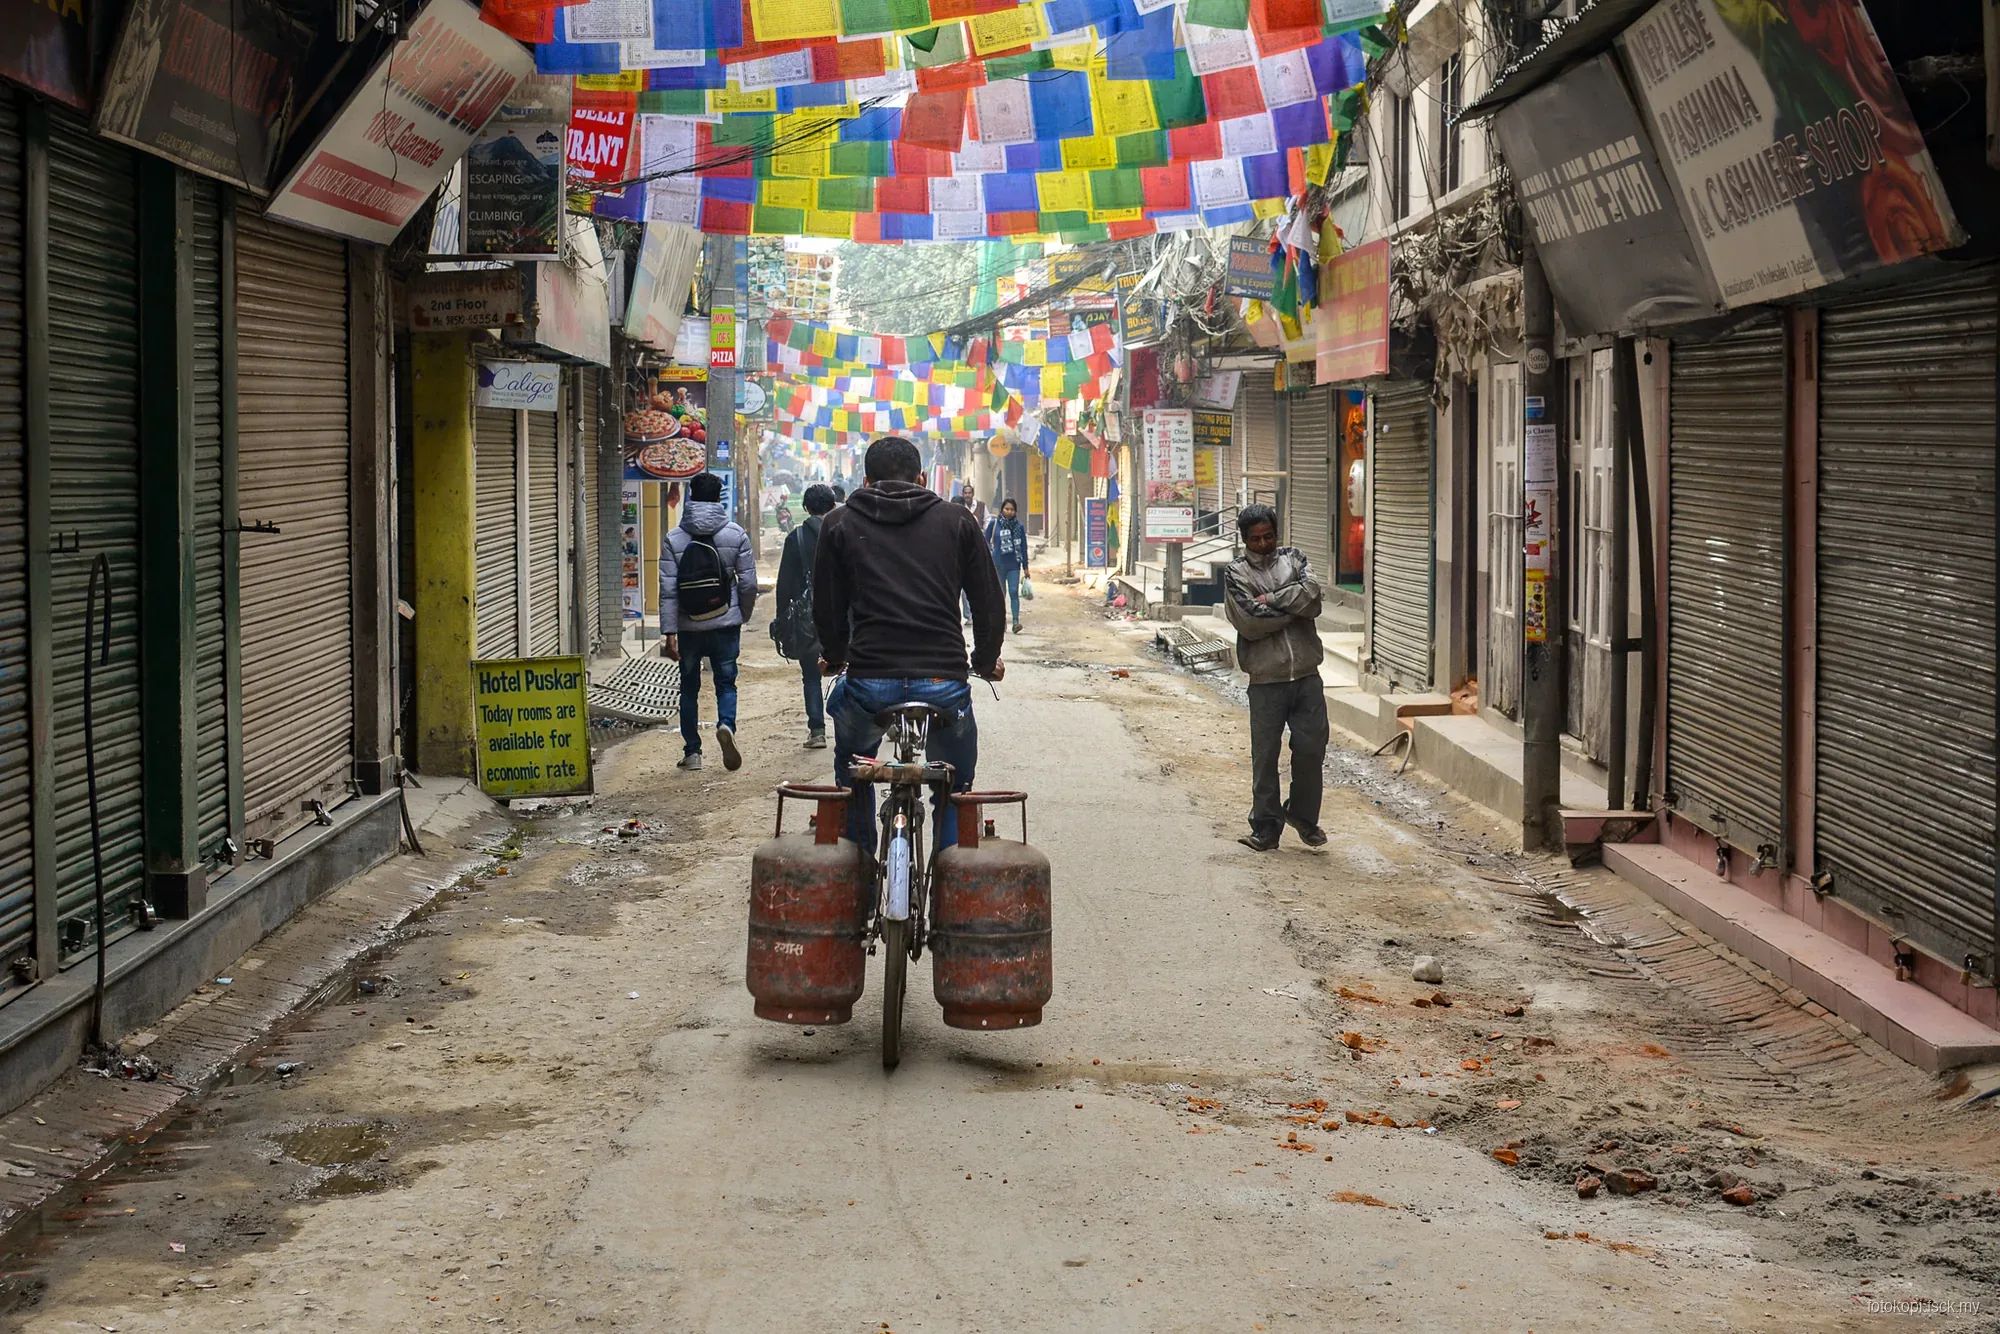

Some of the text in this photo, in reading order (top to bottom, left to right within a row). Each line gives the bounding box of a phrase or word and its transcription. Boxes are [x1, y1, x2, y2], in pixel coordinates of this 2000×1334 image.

[1630, 0, 1715, 88] NEPALESE
[449, 64, 516, 135] LAND
[1659, 65, 1762, 164] PASHMINA
[363, 109, 446, 169] 100% Guarantee
[1690, 187, 1715, 239] &
[1704, 133, 1815, 231] CASHMERE
[1805, 100, 1886, 185] SHOP
[302, 163, 371, 203] MANUFACTURE
[469, 210, 523, 222] CLIMBING!
[1231, 241, 1255, 253] WEL
[430, 300, 488, 312] 2nd Floor
[711, 350, 735, 364] PIZZA
[491, 367, 556, 403] Caligo
[1210, 427, 1231, 437] HOUSE
[622, 480, 637, 501] Spa
[479, 668, 580, 694] Hotel Puskar
[480, 704, 576, 726] Today rooms are
[489, 729, 571, 751] available for
[486, 761, 540, 782] economic
